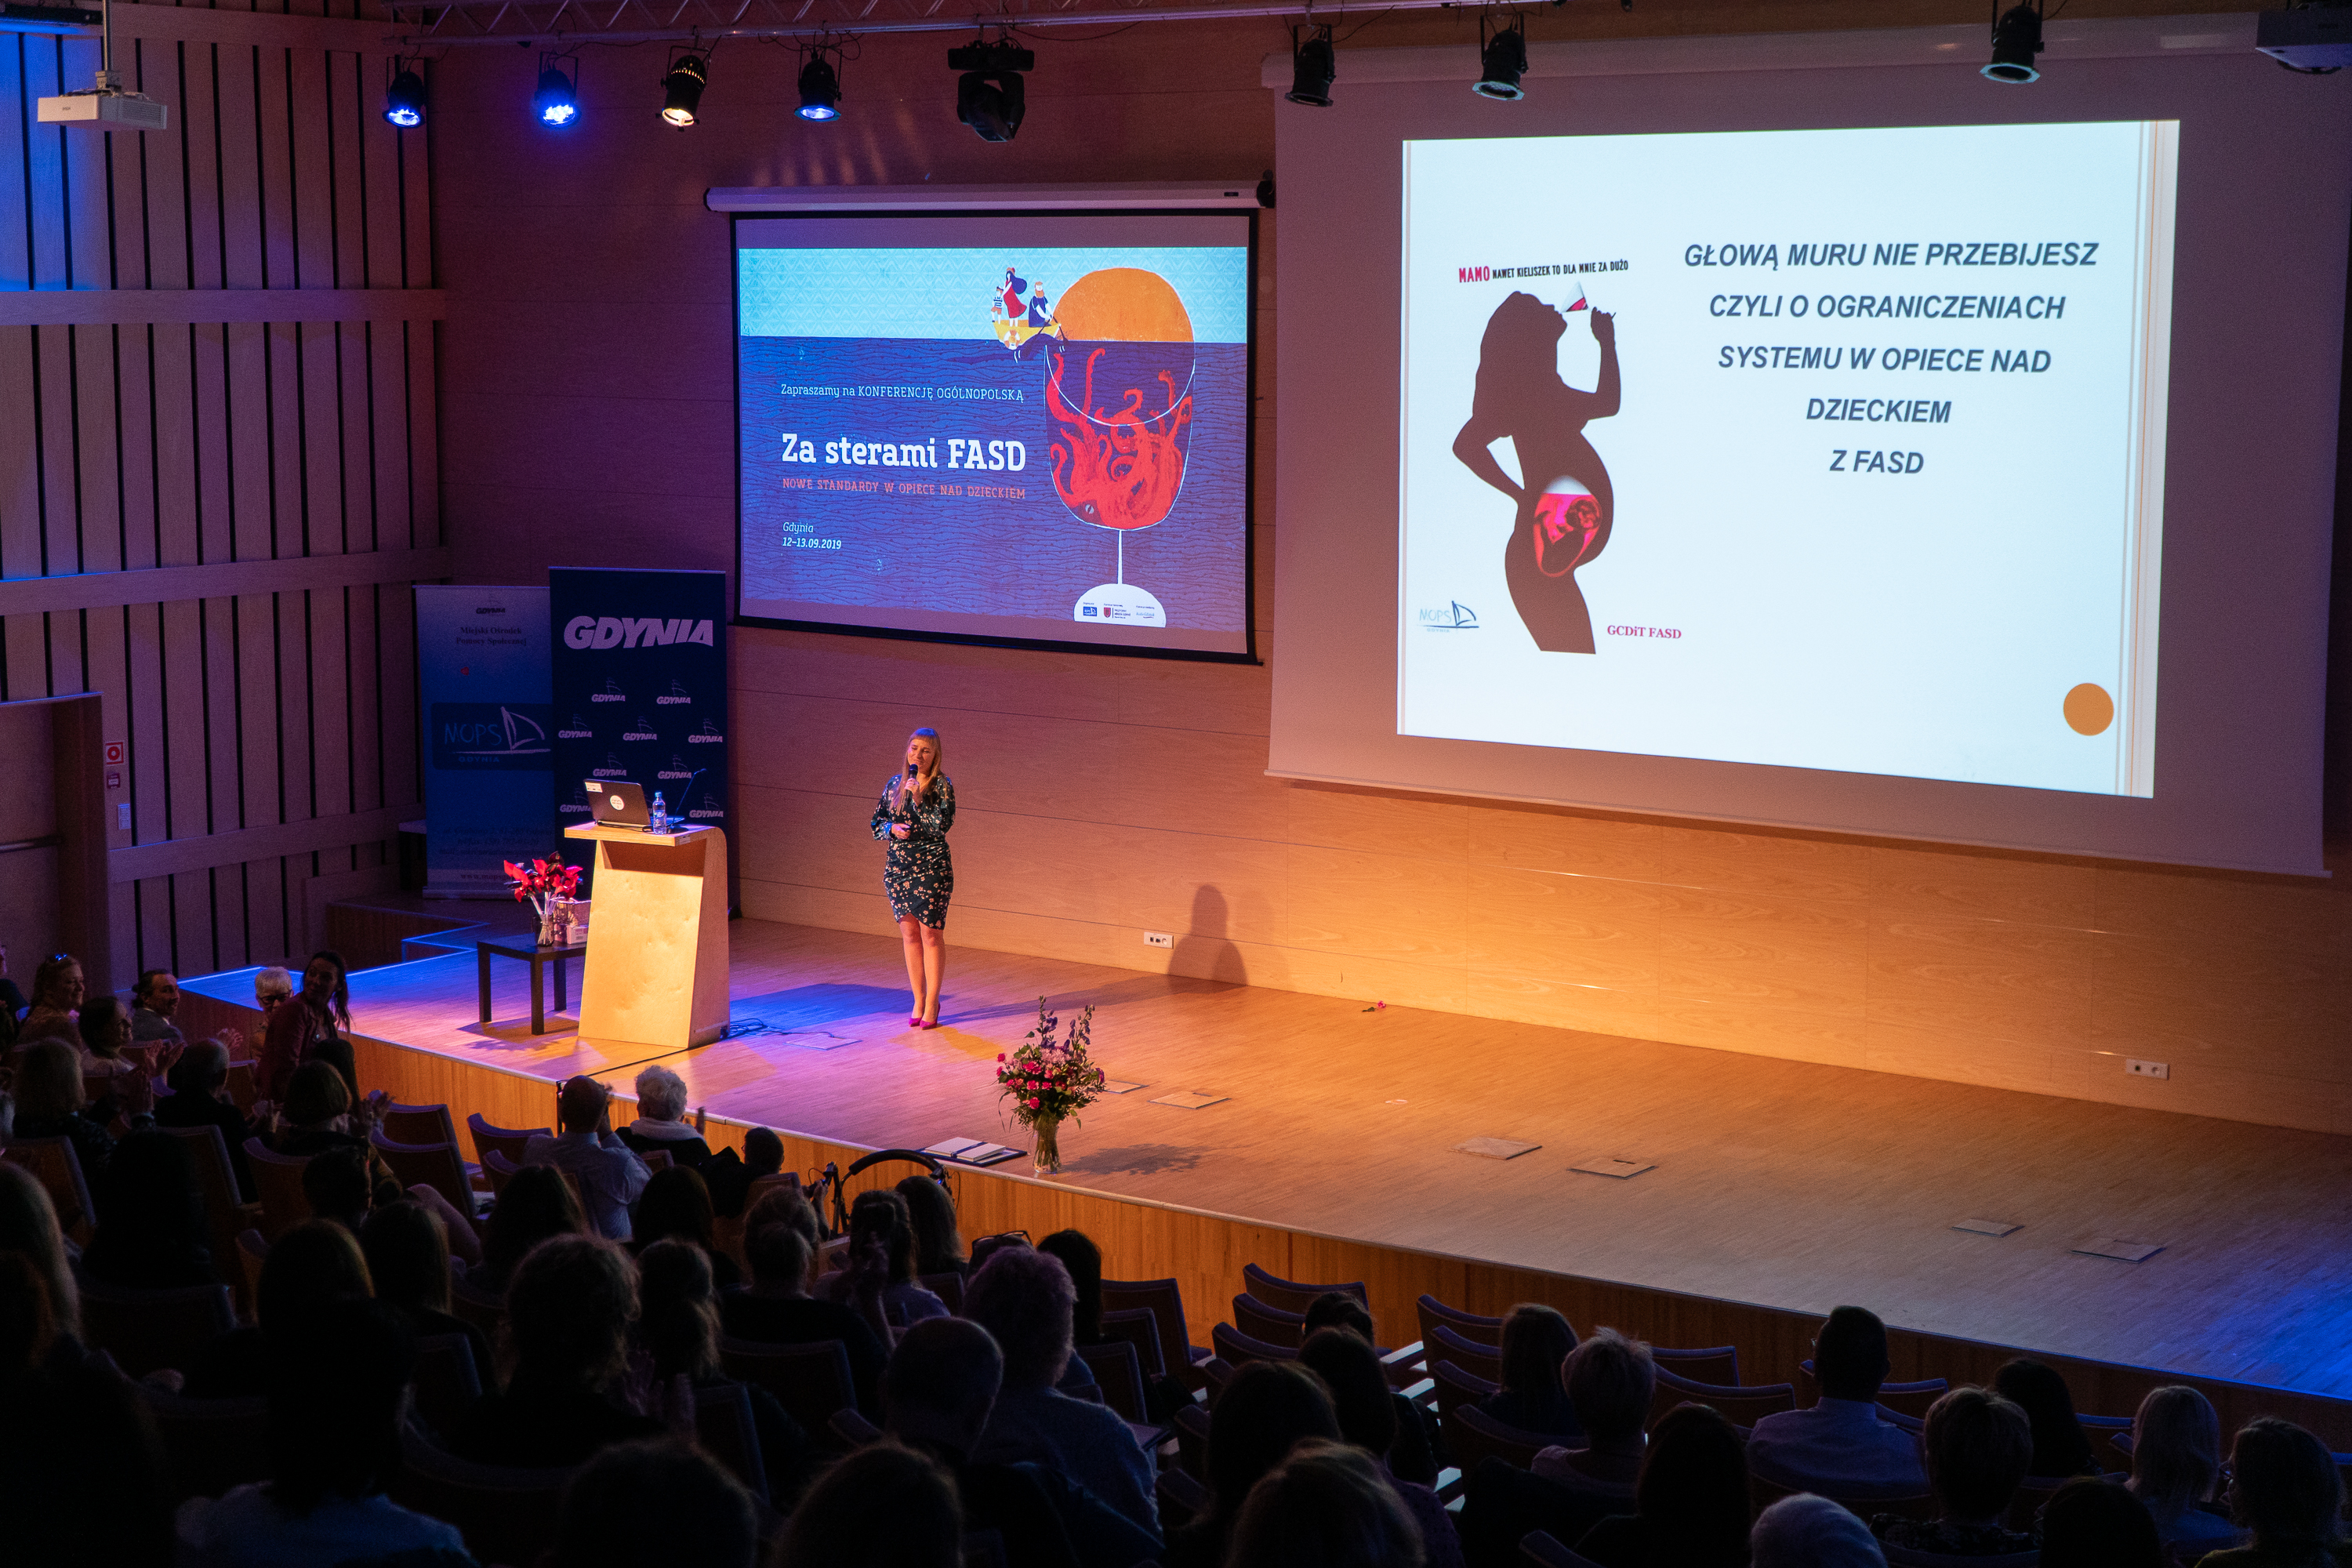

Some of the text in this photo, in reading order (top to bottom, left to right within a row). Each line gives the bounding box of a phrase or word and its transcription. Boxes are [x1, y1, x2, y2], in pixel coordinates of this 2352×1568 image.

[1685, 242, 2099, 271] GŁOWĄ MURU NIE PRZEBIJESZ
[1459, 259, 1628, 283] MAMO NAWET KIELISZEK TO DLA MNIE ZA DUŻO
[1710, 294, 2066, 319] CZYLI O OGRANICZENIACH
[1718, 345, 2052, 372] SYSTEMU W OPIECE NAD
[781, 383, 1025, 404] Zapraszamy na KONFERENCJĘ OGÓLNOPOLSKĄ
[1806, 398, 1951, 423] DZIECKIEM
[782, 433, 1026, 471] Za sterami FASD
[1829, 450, 1924, 474] Z FASD
[782, 478, 1025, 499] NOWE STANDARDY W OPIECE NAD DZIECKIEM
[782, 521, 814, 535] Gdynia
[1419, 608, 1452, 624] MOPS
[460, 626, 488, 636] Miejski
[563, 615, 713, 650] GDYNIA
[1648, 627, 1682, 639] FASD
[487, 637, 527, 647] Społecznej
[591, 694, 626, 702] GDYNIA
[656, 695, 691, 705] GDYNIA
[444, 722, 503, 746] MOPS
[558, 729, 592, 739] GDYNIA
[622, 732, 657, 741] GDYNIA
[688, 734, 723, 743] GDYNIA
[593, 768, 626, 777] GDYNIA
[658, 771, 692, 779] GDYNIA
[689, 809, 724, 818] GDYNIA
